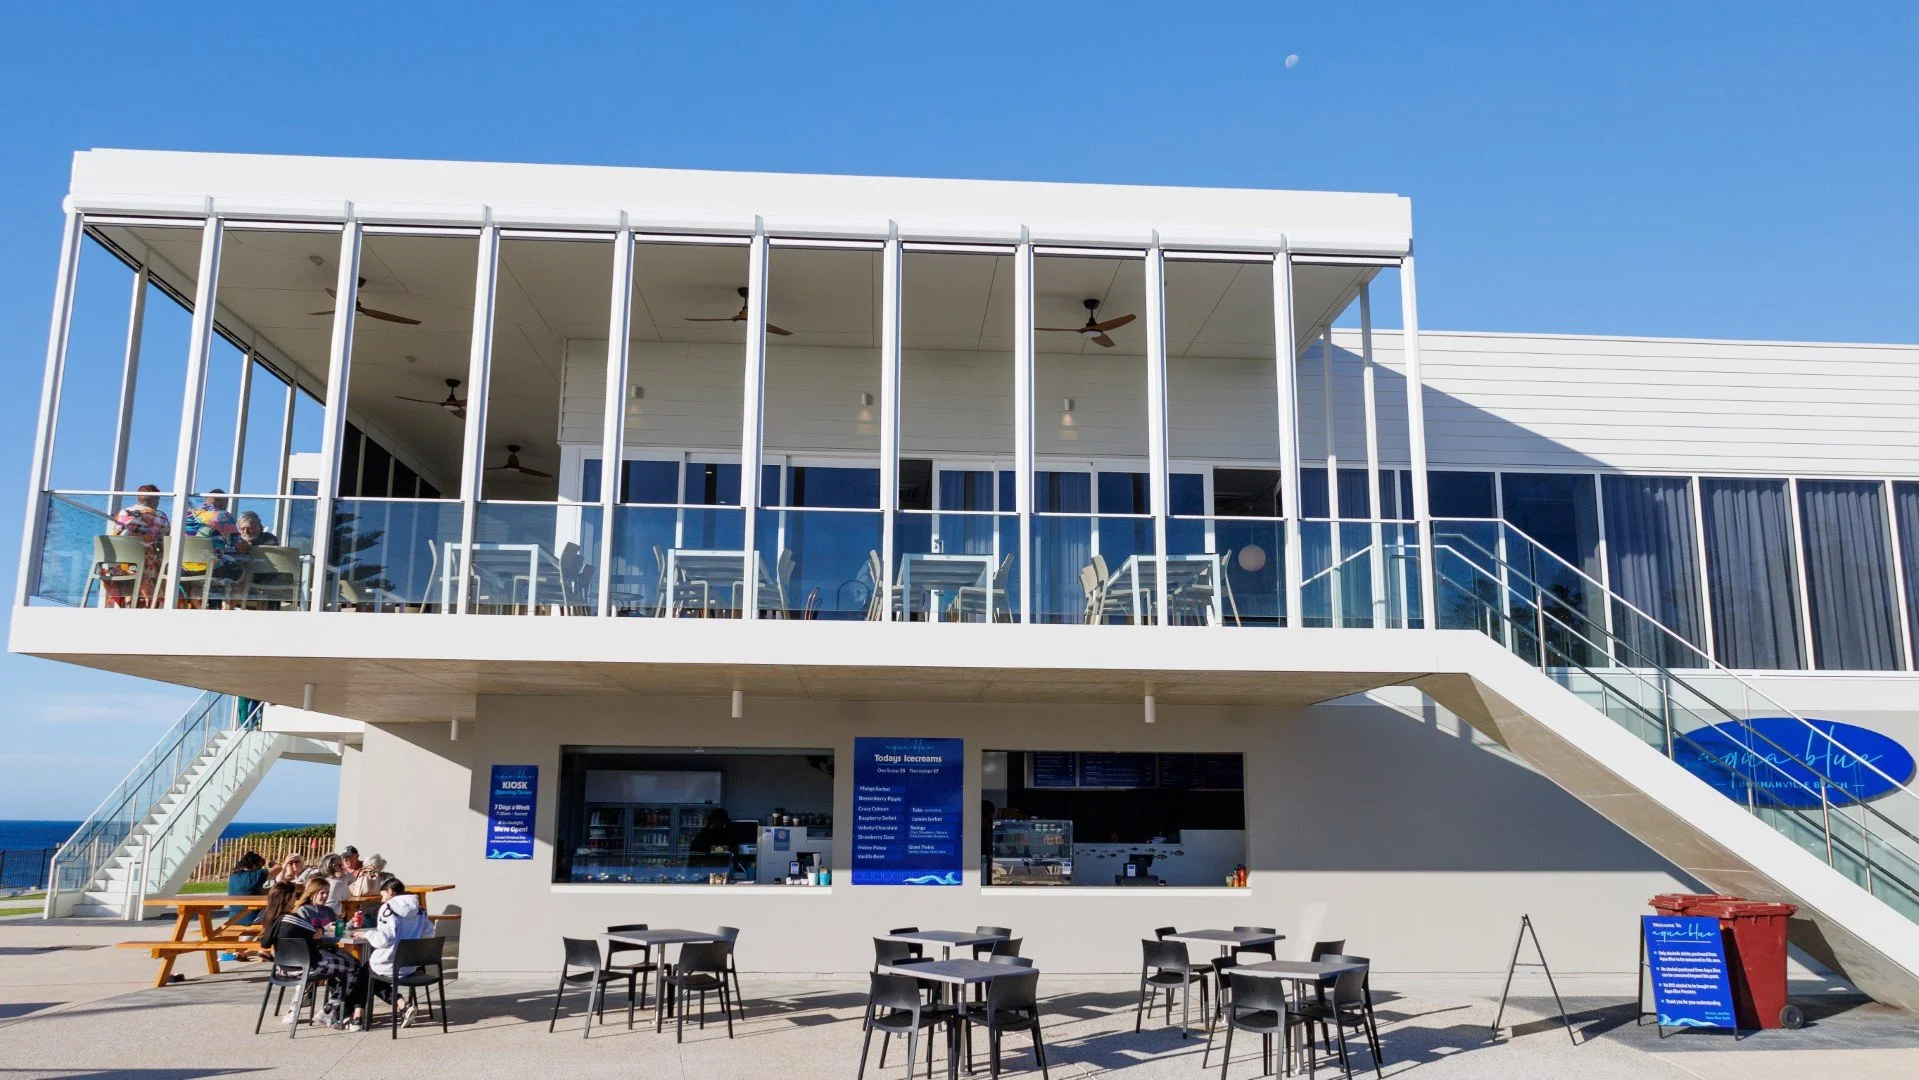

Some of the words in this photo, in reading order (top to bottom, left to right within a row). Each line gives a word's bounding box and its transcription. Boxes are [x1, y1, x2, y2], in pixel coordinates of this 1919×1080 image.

[874, 754, 902, 764] Todays
[904, 754, 942, 763] Icecreams
[1698, 751, 1799, 790] aqua
[1805, 724, 1884, 778] blue
[502, 781, 528, 789] KIOSK
[1739, 781, 1810, 789] NMANVILE
[1652, 930, 1687, 943] aqua
[1688, 923, 1715, 940] blue
